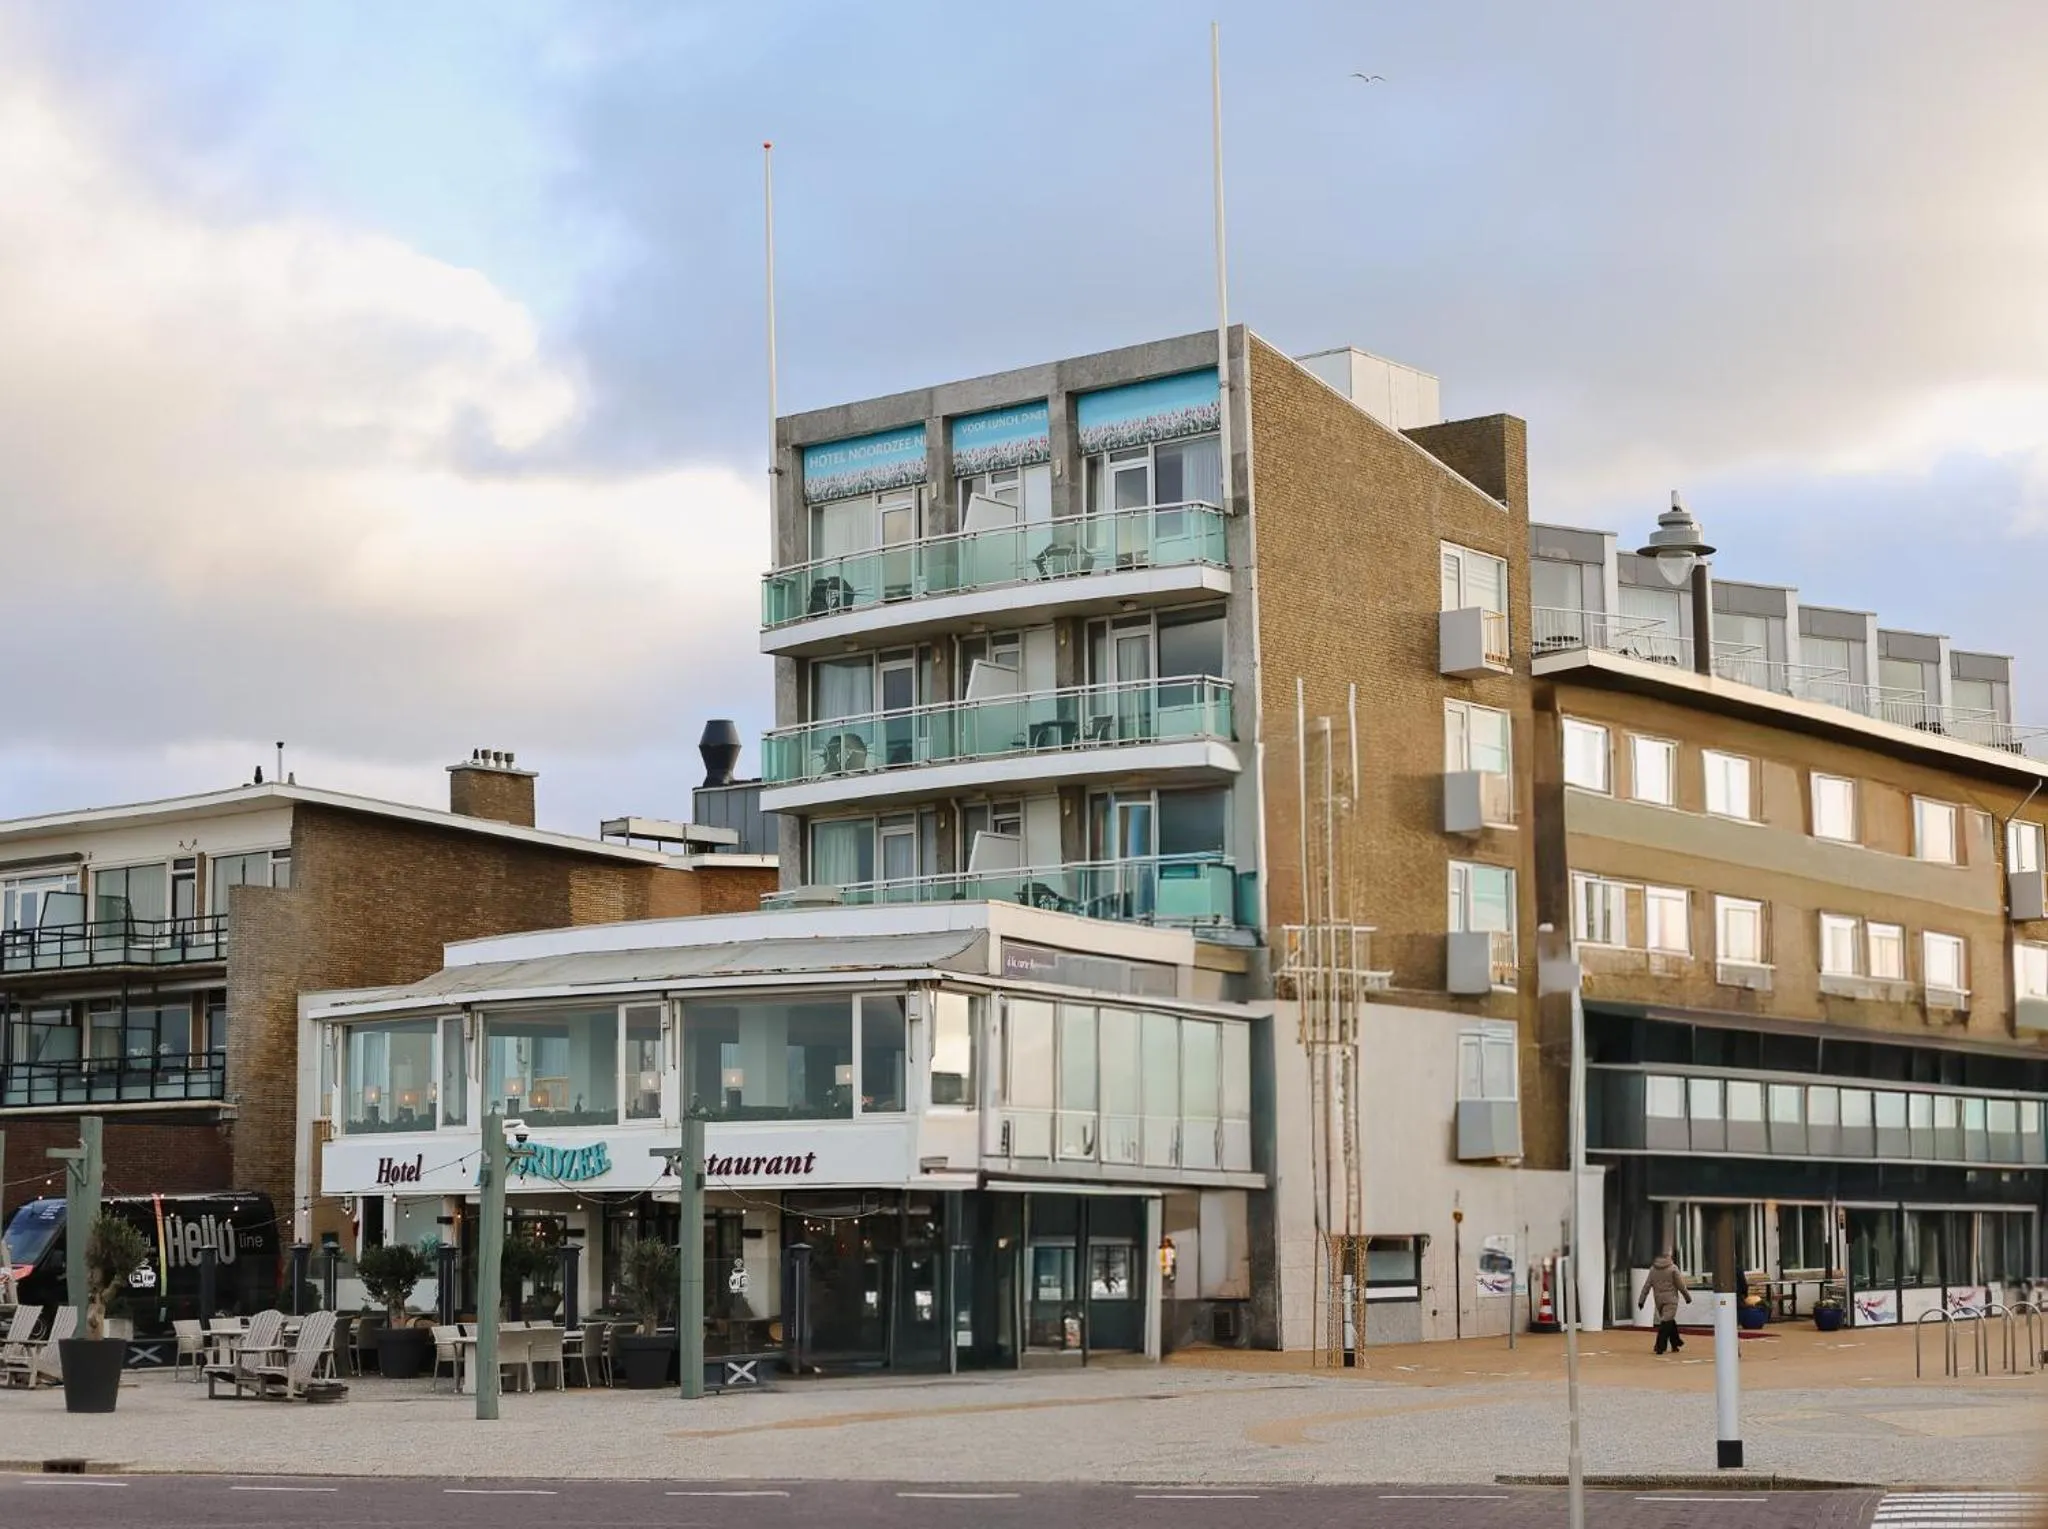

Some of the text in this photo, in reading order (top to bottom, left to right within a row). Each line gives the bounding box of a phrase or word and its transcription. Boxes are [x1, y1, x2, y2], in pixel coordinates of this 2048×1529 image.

[809, 451, 846, 468] HOTEL
[376, 1153, 423, 1184] Hotel
[164, 1213, 237, 1268] Hello
[239, 1231, 263, 1248] line
